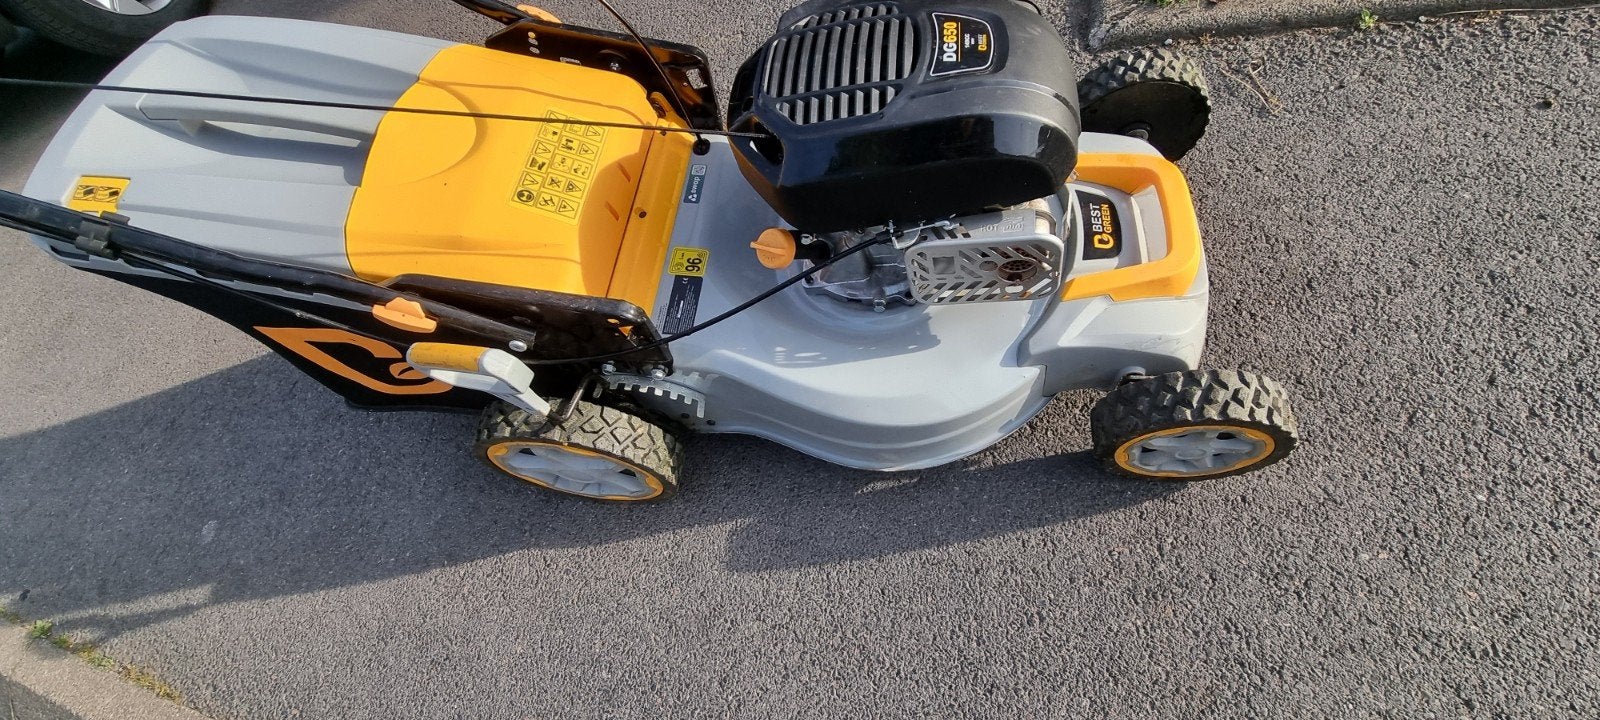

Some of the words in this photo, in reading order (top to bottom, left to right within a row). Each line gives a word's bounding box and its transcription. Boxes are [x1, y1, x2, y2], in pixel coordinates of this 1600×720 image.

[943, 21, 957, 62] DG650
[1090, 203, 1103, 232] BEST
[1101, 204, 1112, 233] GREEN
[685, 257, 702, 272] 96
